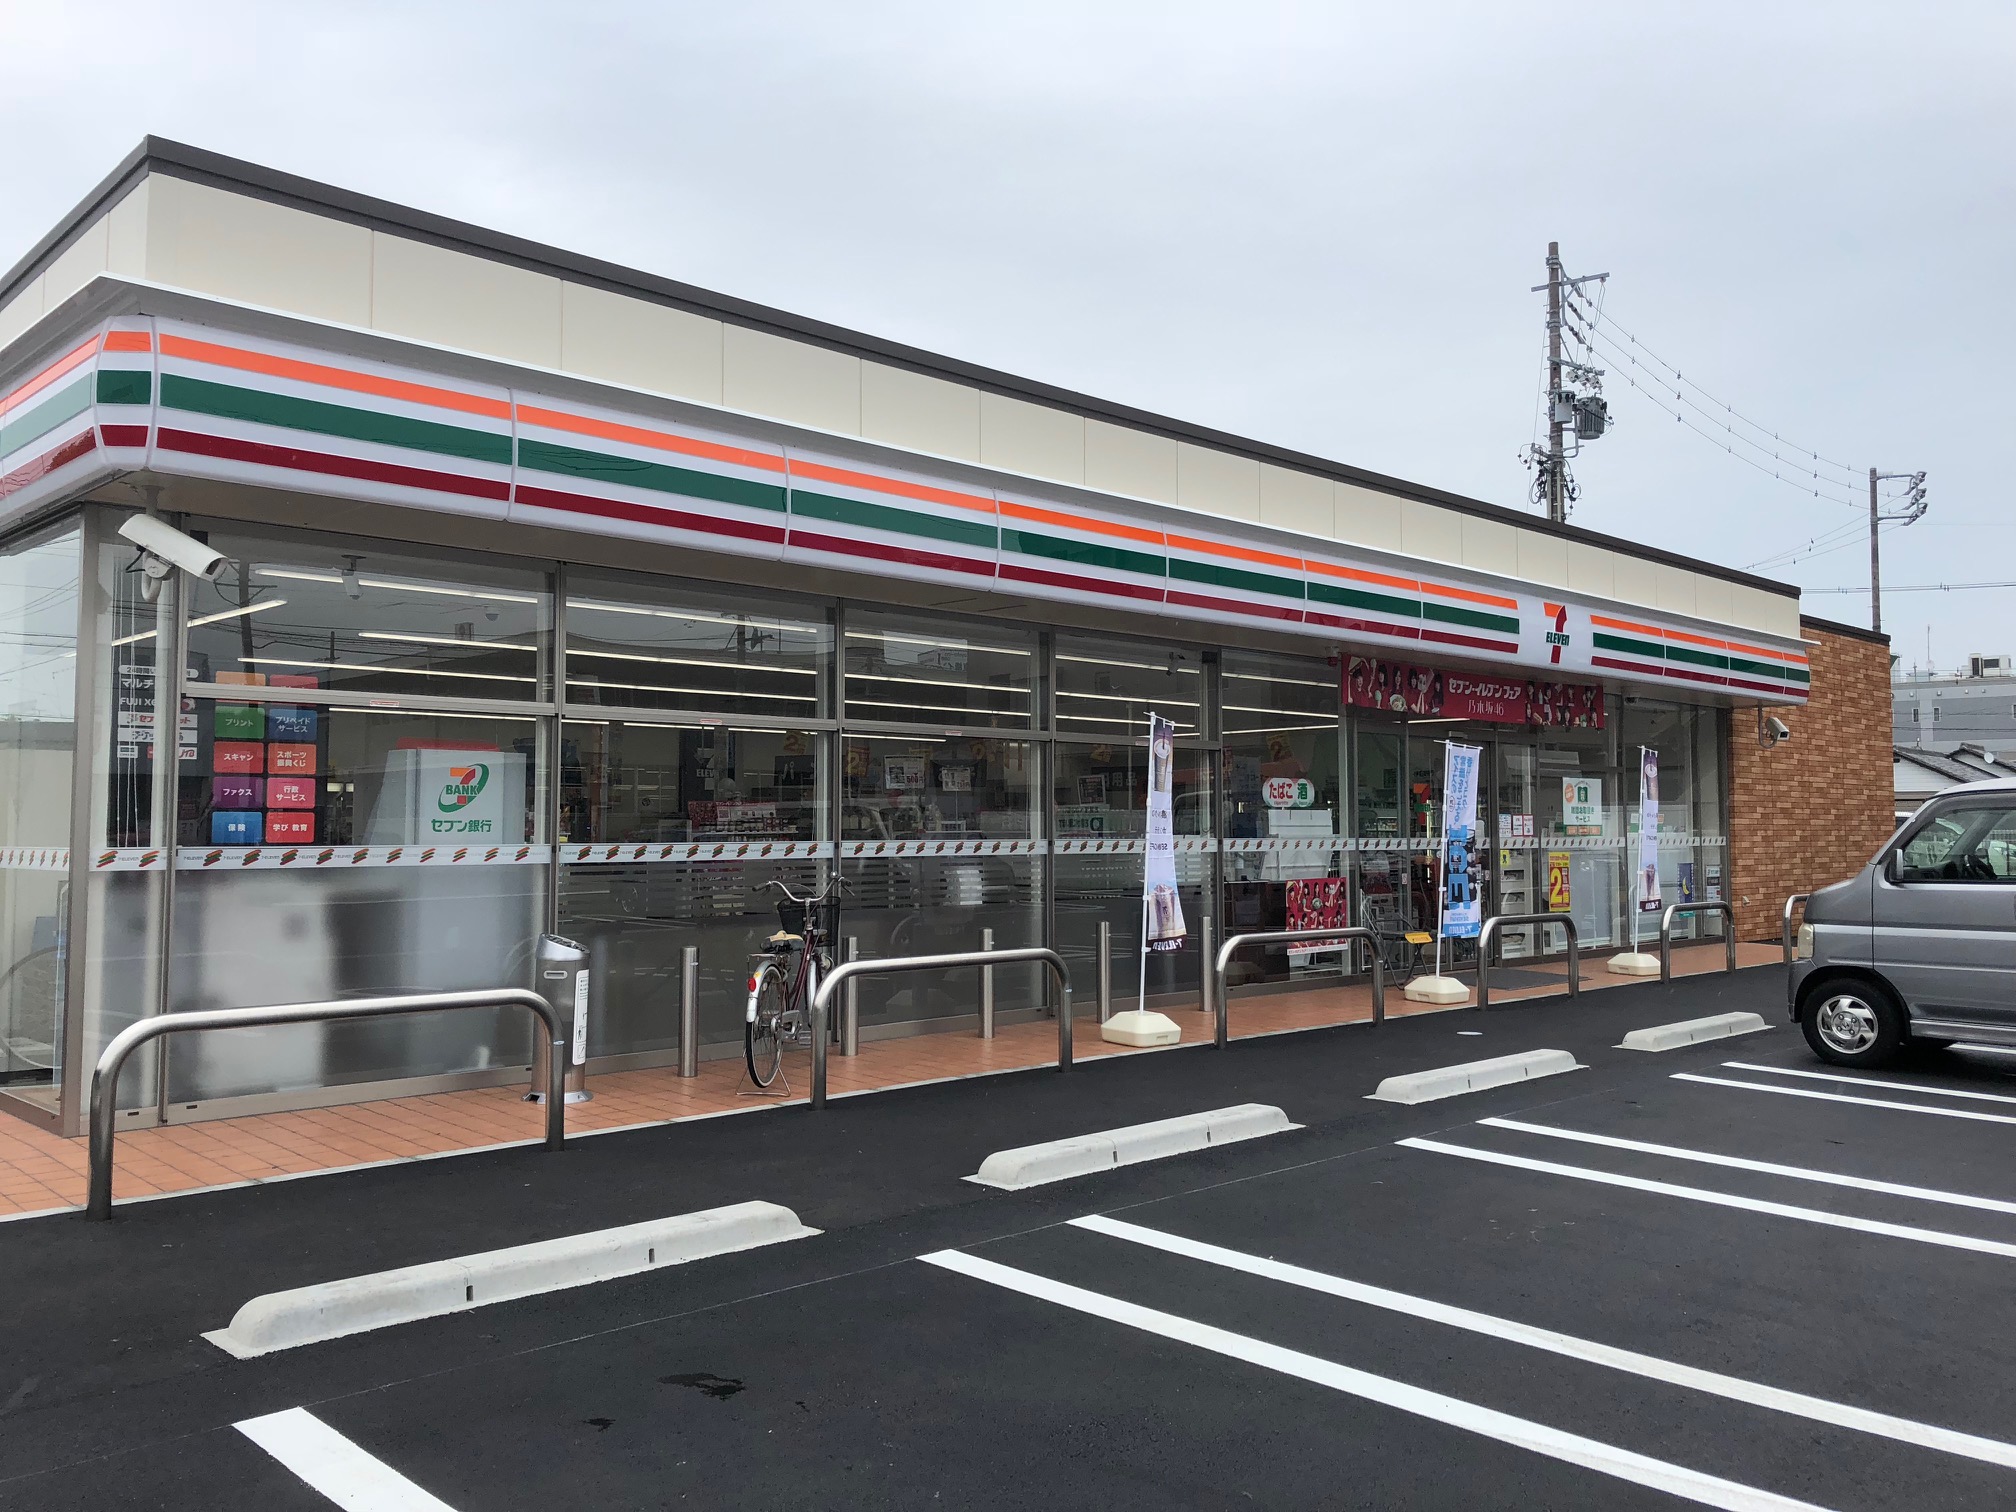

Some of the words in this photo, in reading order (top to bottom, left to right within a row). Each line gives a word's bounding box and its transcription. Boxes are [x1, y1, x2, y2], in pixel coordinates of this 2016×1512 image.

[1544, 602, 1567, 664] 7
[121, 679, 154, 688] マルチ
[120, 698, 142, 706] FUJI
[225, 718, 254, 727] プリント
[275, 716, 311, 725] プリペイド
[278, 725, 308, 733] サービス
[223, 753, 254, 762] スキャン
[277, 751, 307, 759] スポーツ
[223, 788, 253, 796] ファクス
[283, 786, 299, 794] 行政
[446, 785, 480, 795] BANK
[1269, 782, 1293, 799] たばこ
[1297, 783, 1308, 800] 酒
[276, 793, 306, 802] サービス
[431, 819, 492, 833] セブン銀行
